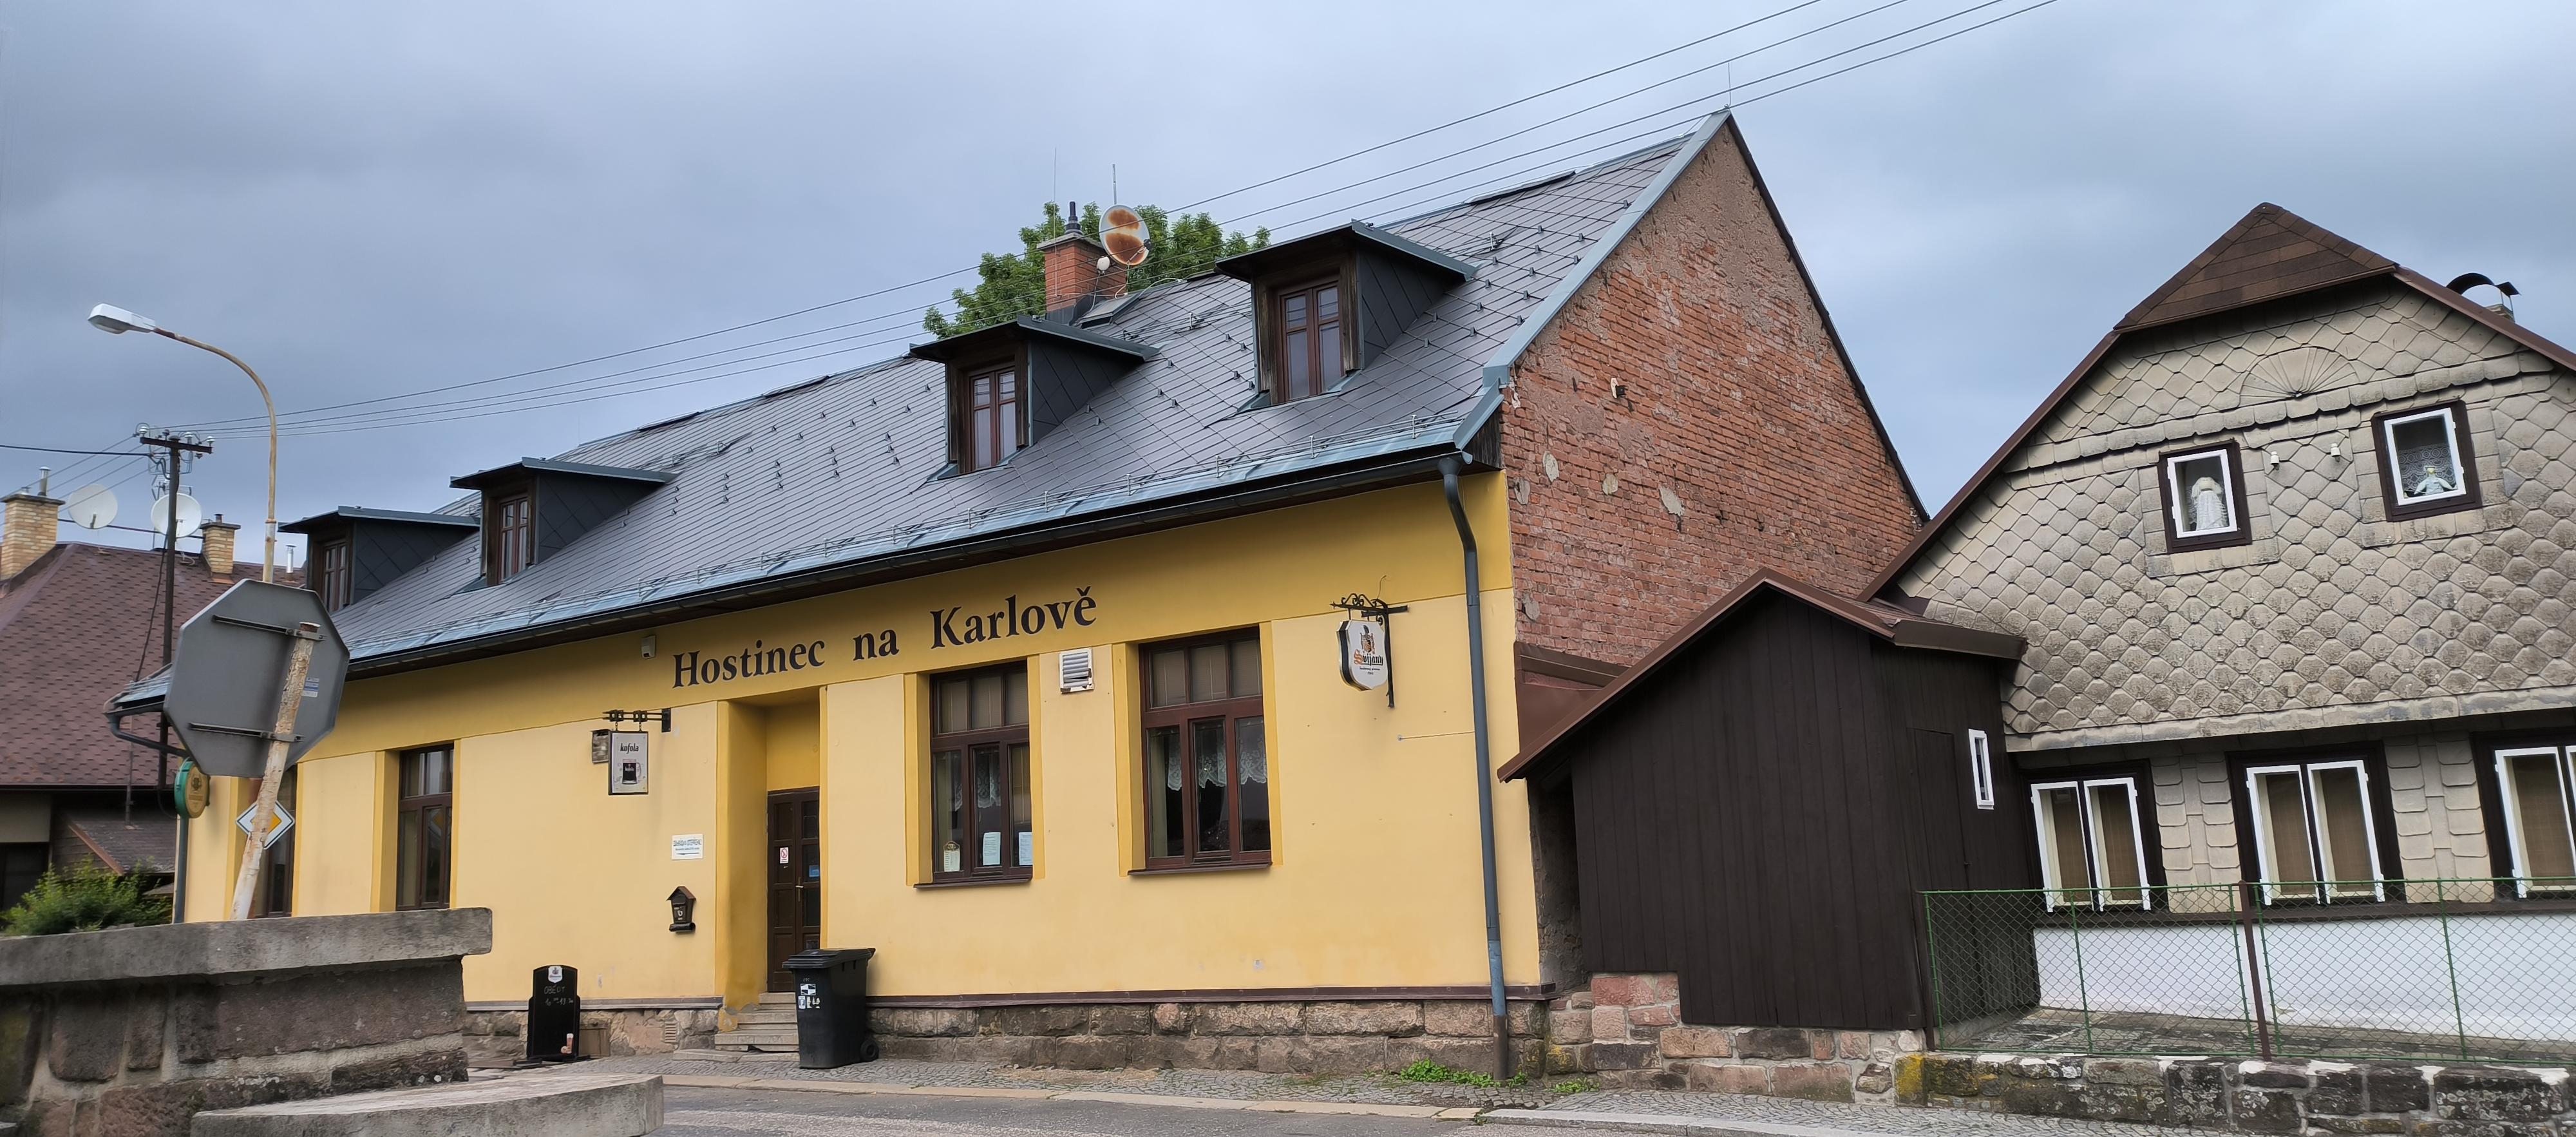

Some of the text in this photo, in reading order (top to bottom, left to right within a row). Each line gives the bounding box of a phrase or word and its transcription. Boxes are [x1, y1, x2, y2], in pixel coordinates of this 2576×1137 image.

[672, 586, 1097, 689] Hostinec na Karlově
[1354, 649, 1383, 666] Svijany
[620, 743, 639, 754] kofola
